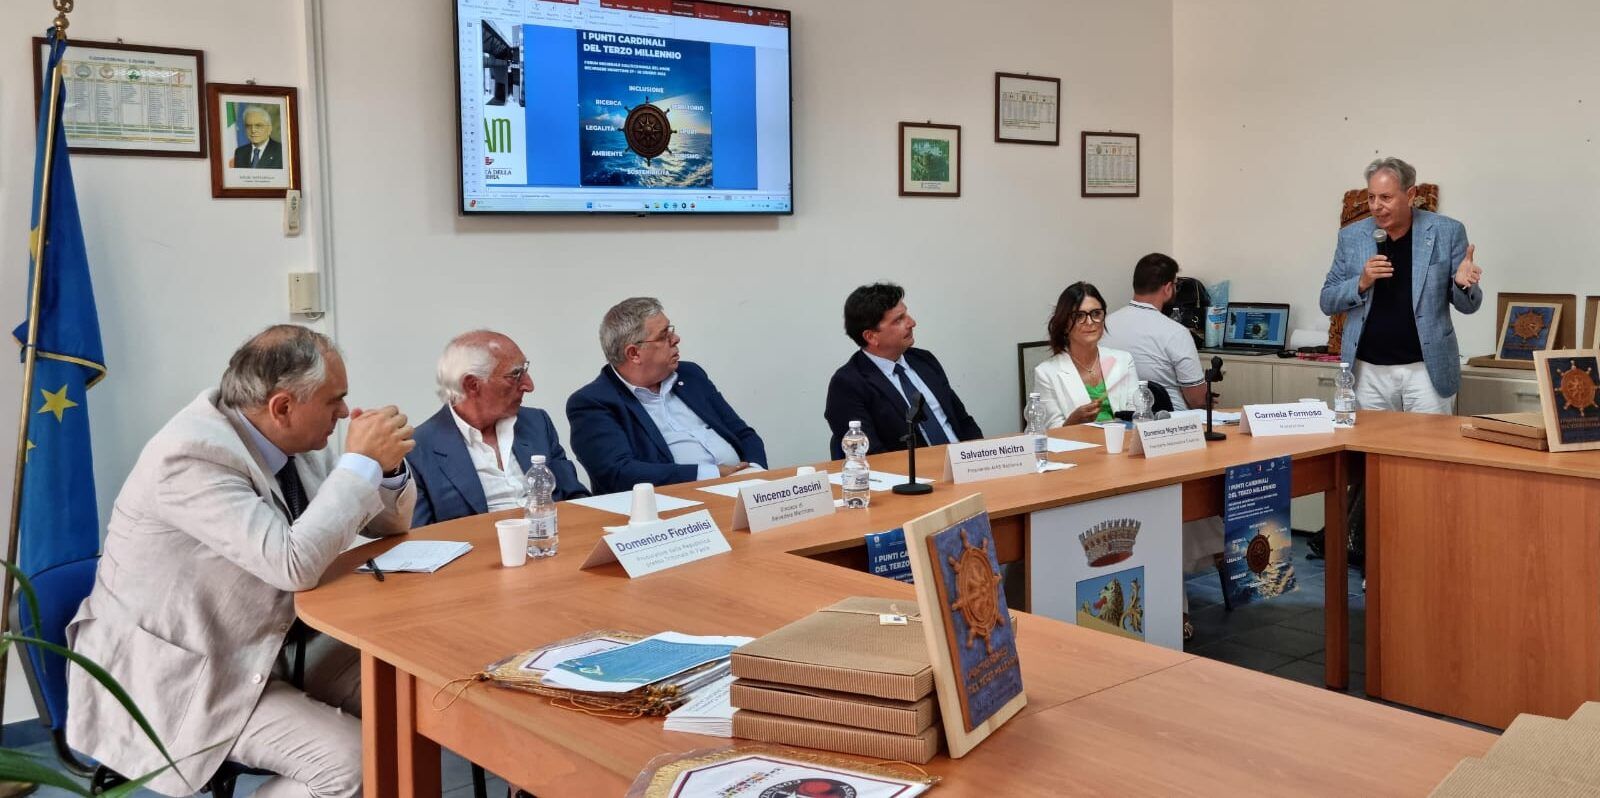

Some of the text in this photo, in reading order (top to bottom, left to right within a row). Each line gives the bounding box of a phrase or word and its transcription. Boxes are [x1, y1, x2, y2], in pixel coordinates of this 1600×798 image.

[588, 33, 616, 42] PUNTI
[618, 36, 666, 47] CARDINALI
[583, 44, 681, 60] DEL TERZO MILLENNIO
[960, 445, 1024, 460] Salvatore Nicitra
[753, 480, 821, 503] Vincenzo Cascini
[616, 519, 711, 552] Domenico Fiordalisi
[879, 552, 898, 562] PUNTI
[889, 561, 910, 570] TERZO
